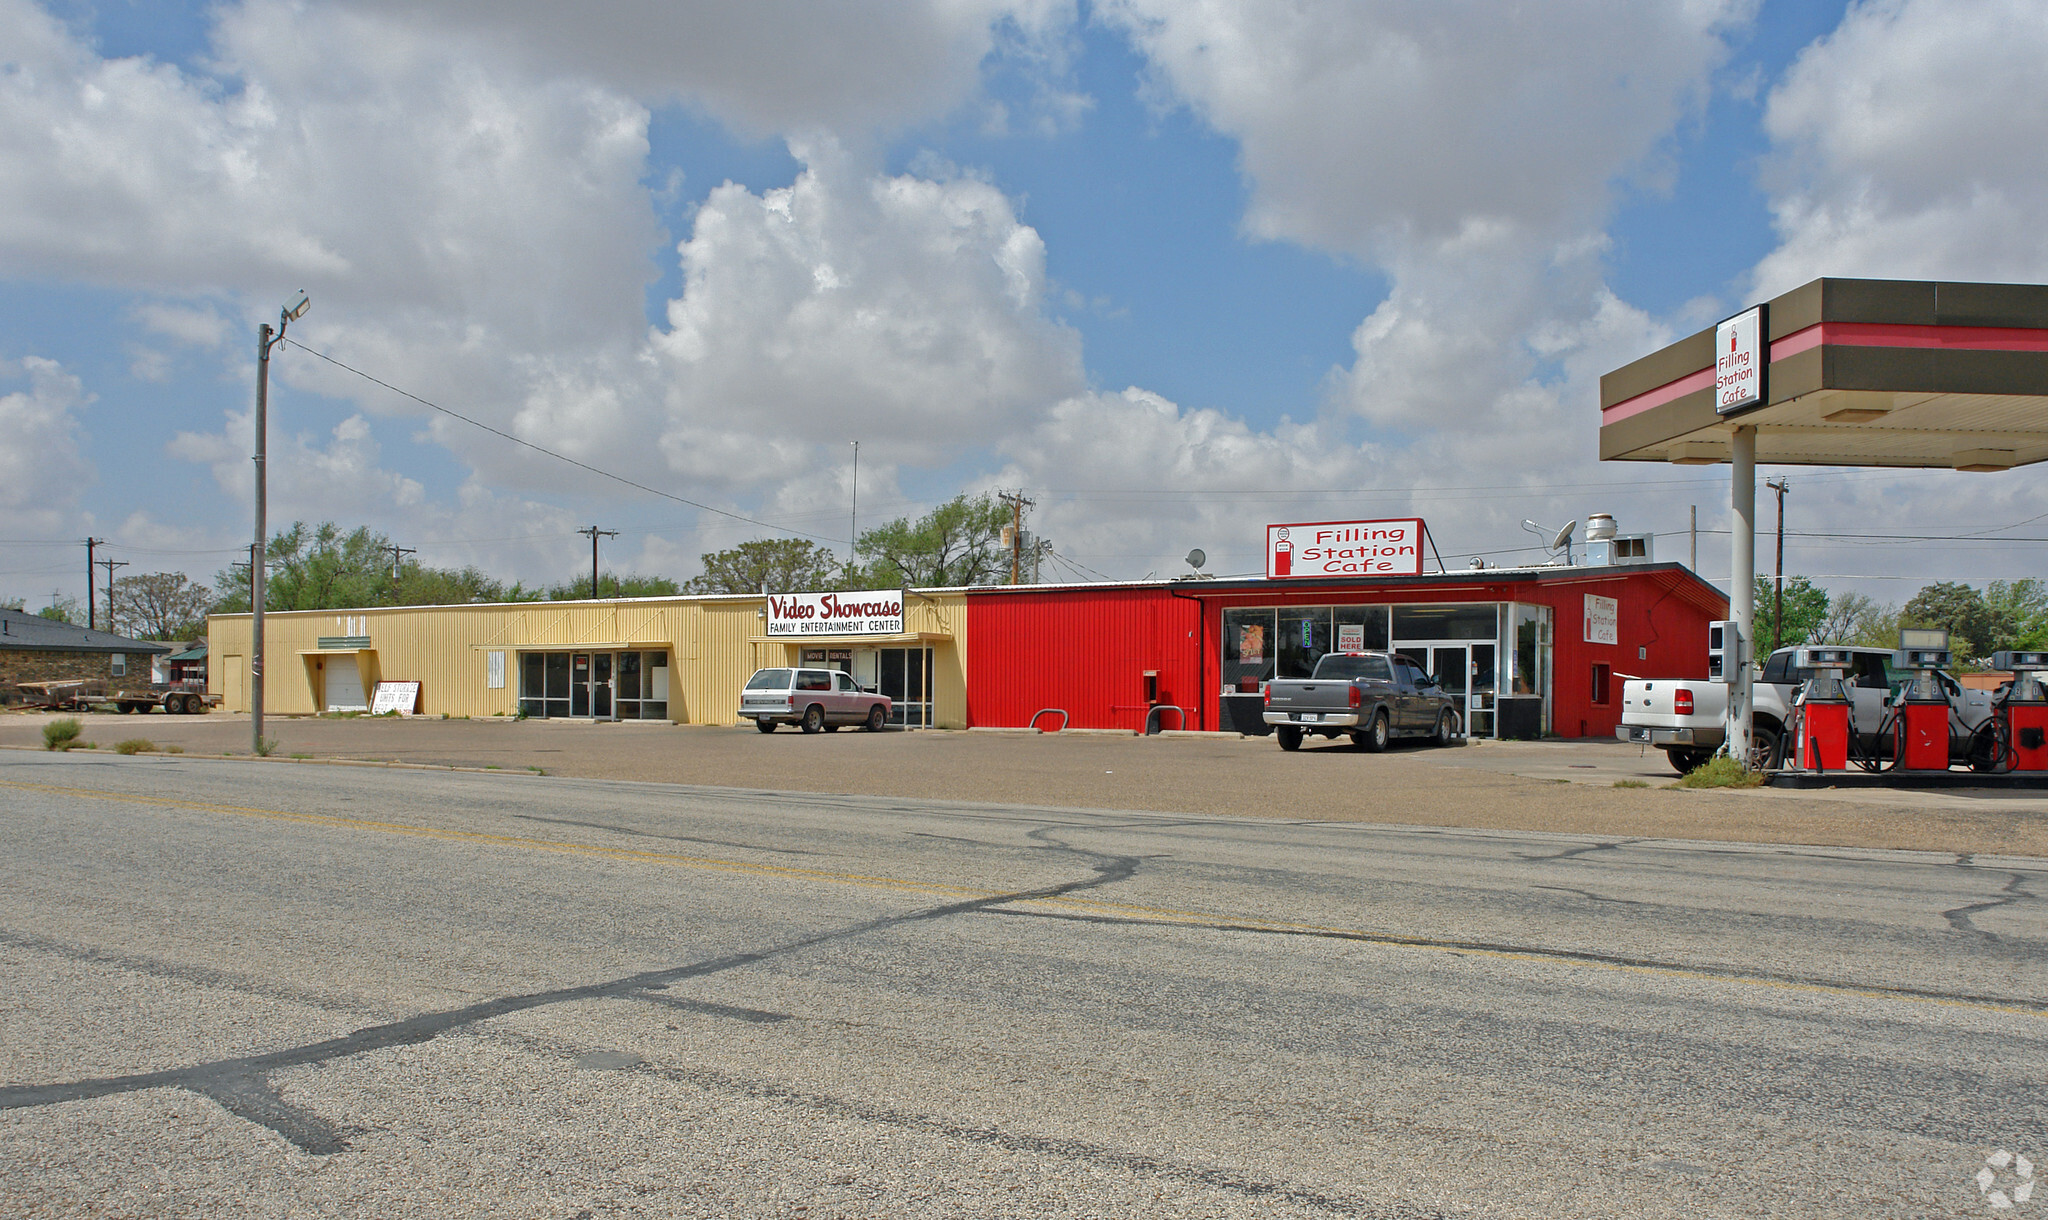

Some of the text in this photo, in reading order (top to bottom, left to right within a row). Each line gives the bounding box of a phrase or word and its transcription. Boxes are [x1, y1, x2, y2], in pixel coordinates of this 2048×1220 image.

[1718, 351, 1750, 373] Filling
[1716, 368, 1753, 390] Station
[1722, 386, 1747, 405] Cafe
[1316, 528, 1405, 545] Filling
[1302, 545, 1415, 561] Station
[1323, 558, 1394, 573] Cafe
[769, 594, 902, 620] Video Showcase
[1595, 598, 1615, 615] Filling
[770, 620, 900, 633] FAMILY ENTERTAINMENT CENTER
[1592, 613, 1616, 627] Station
[1597, 629, 1614, 641] Cafe
[807, 652, 852, 660] MOVIE RENTALS
